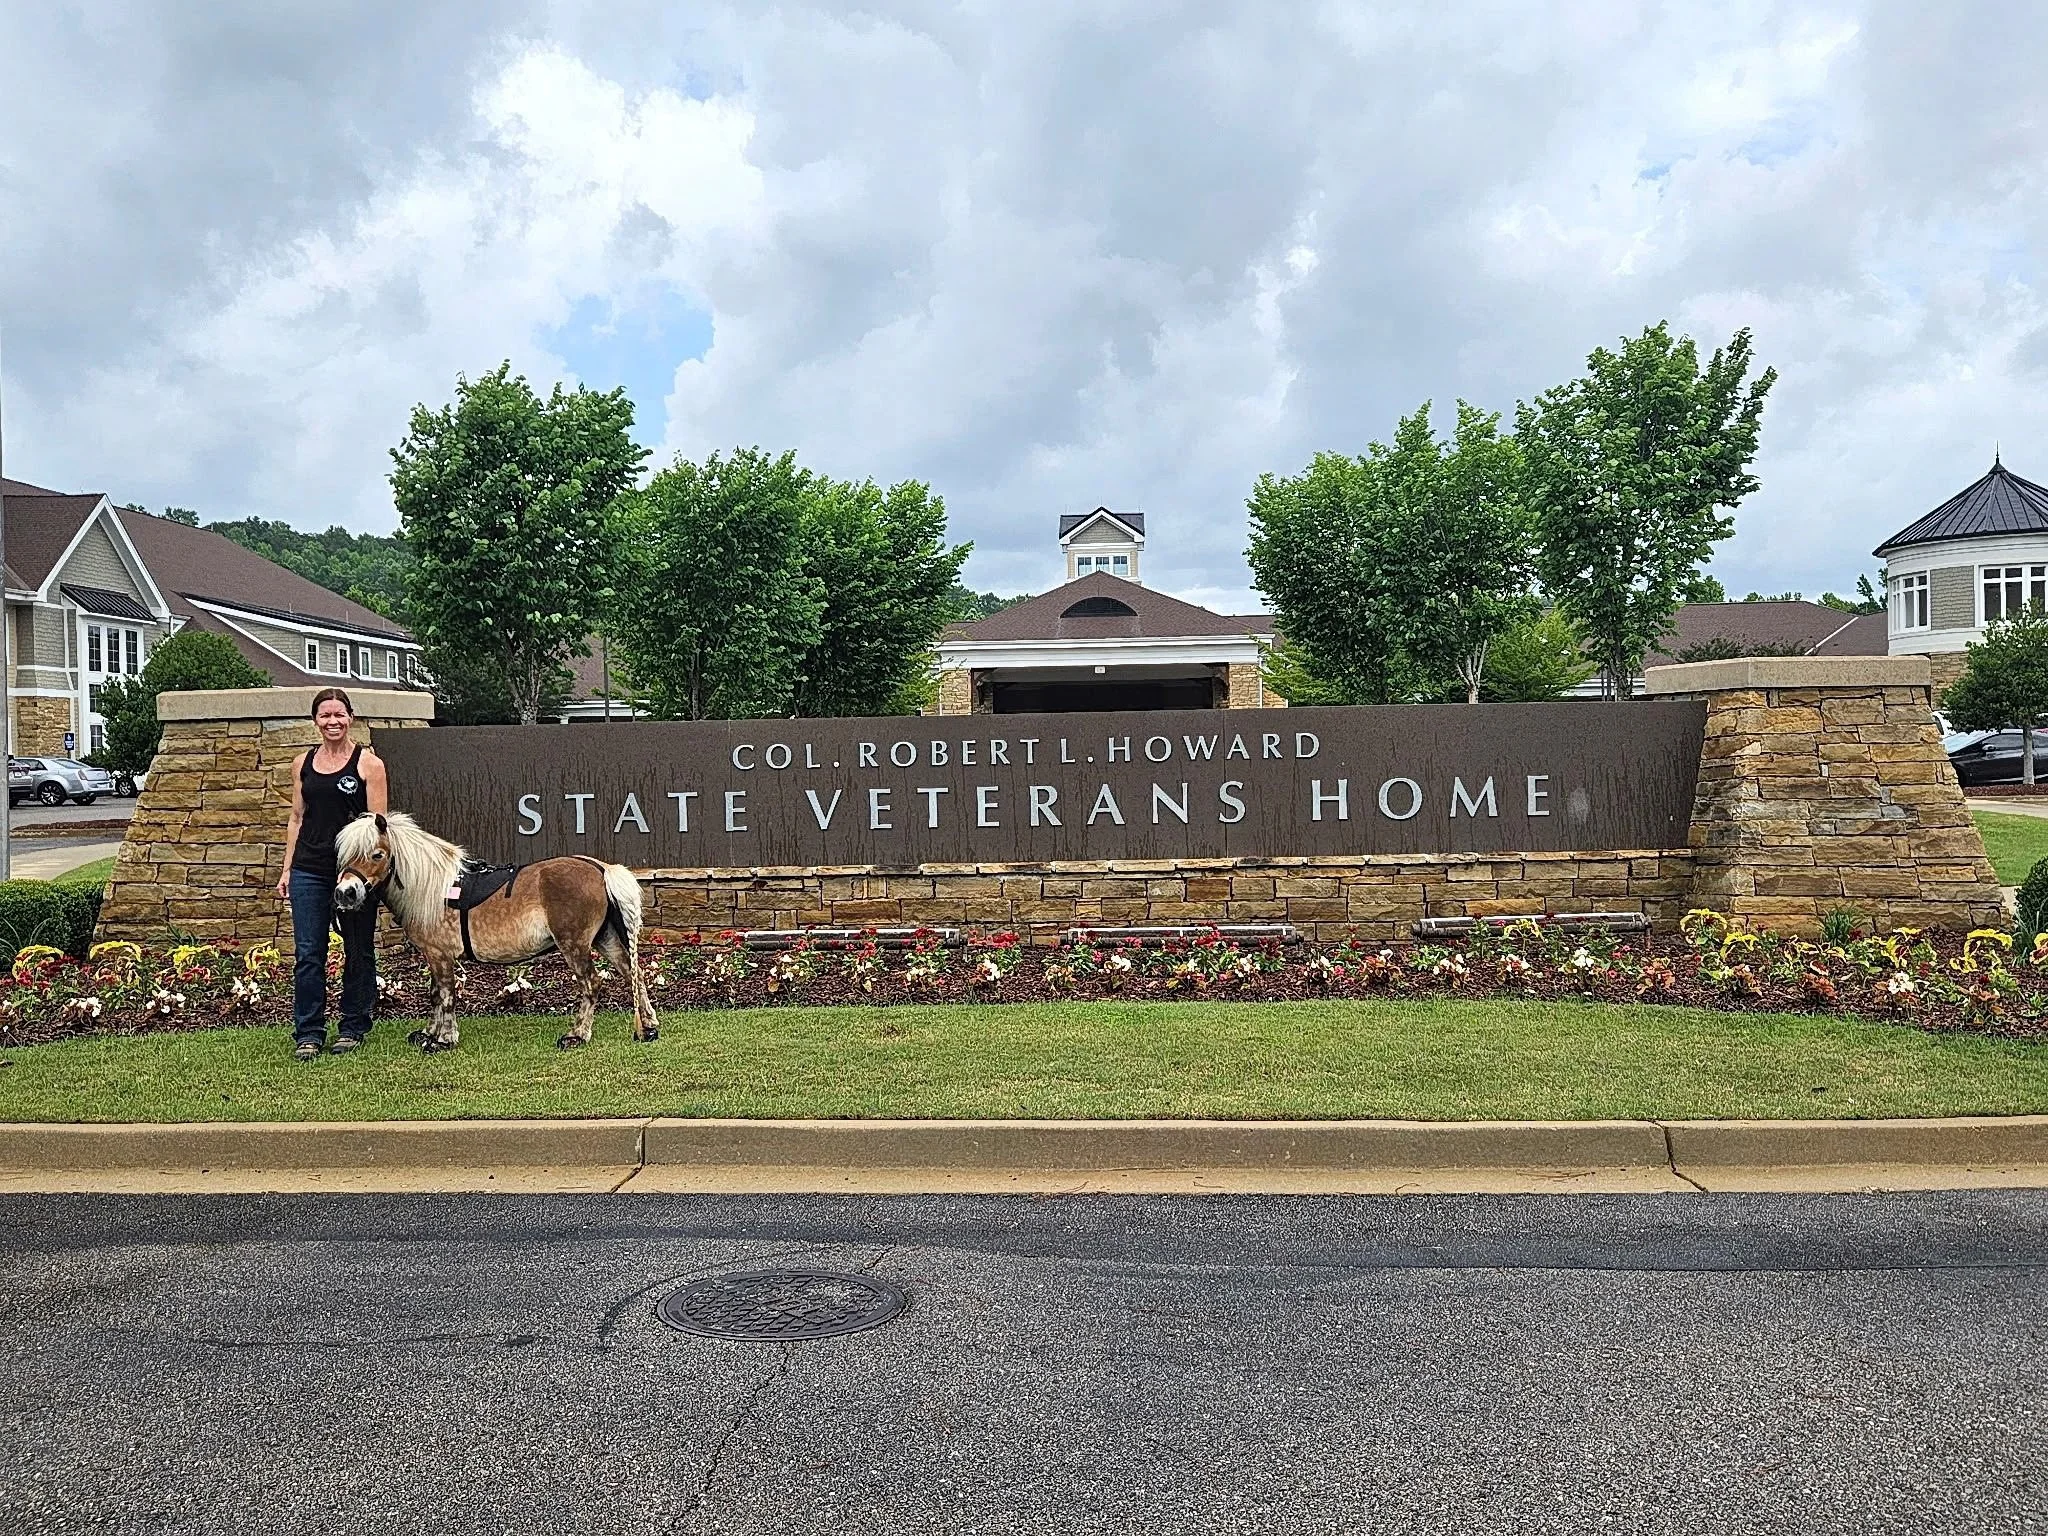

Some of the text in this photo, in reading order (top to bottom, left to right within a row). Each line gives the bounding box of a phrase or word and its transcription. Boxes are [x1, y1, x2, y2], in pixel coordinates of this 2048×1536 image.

[731, 732, 1321, 770] COL. ROBERT L. HOWARD
[518, 774, 1551, 835] STATE VETERANS HOME
